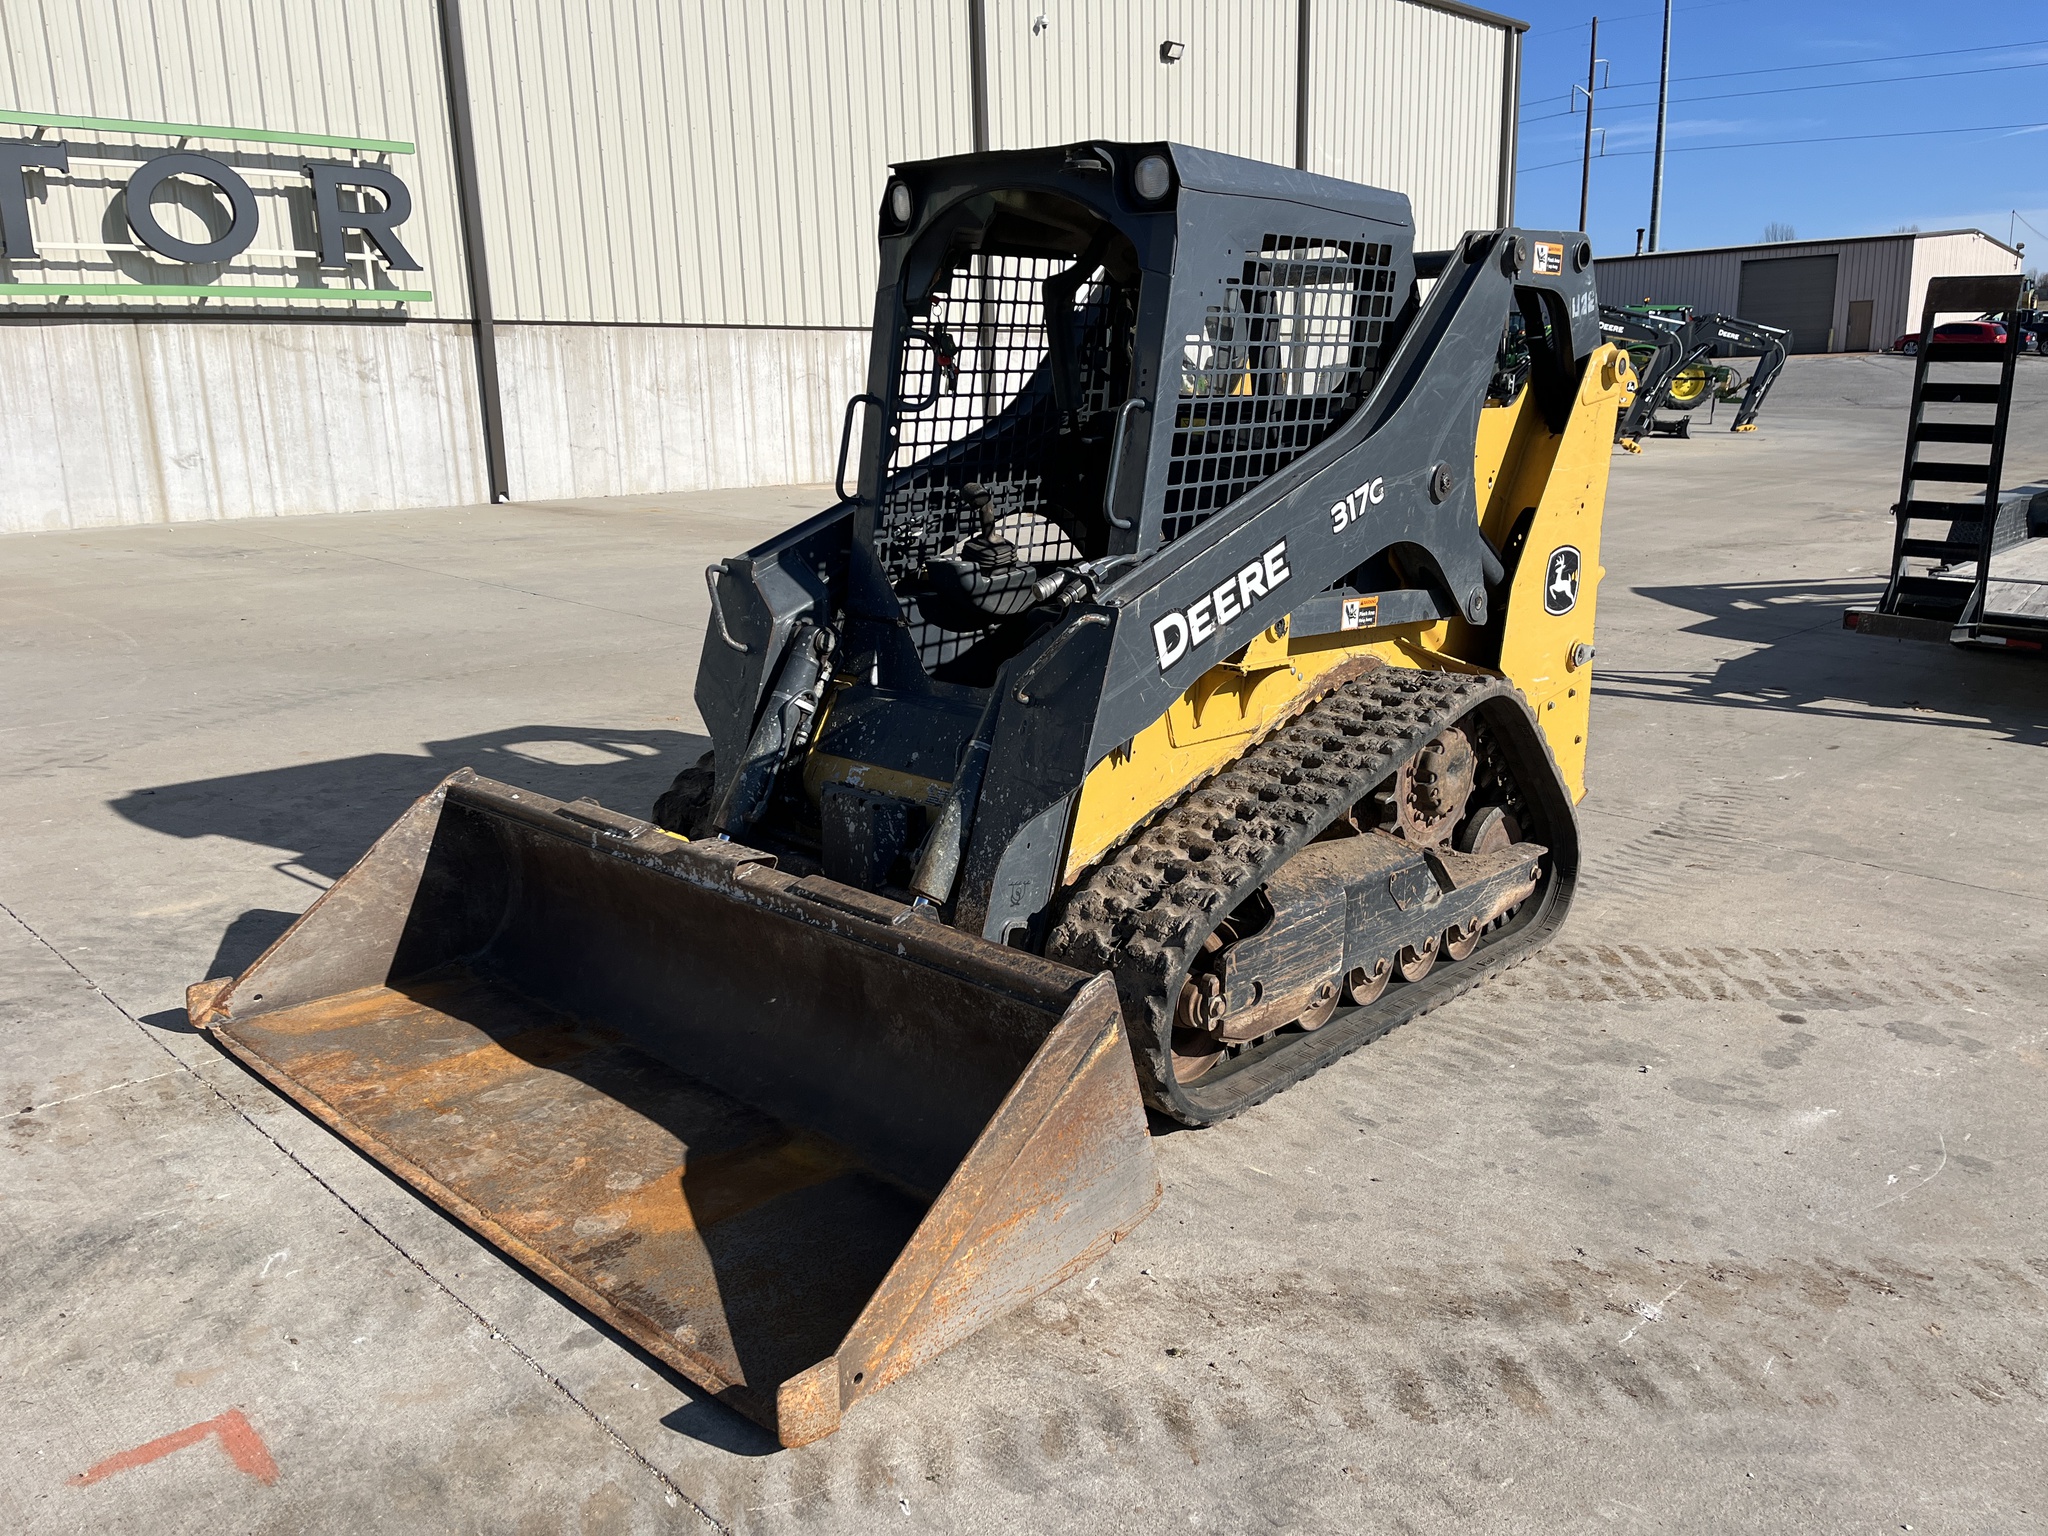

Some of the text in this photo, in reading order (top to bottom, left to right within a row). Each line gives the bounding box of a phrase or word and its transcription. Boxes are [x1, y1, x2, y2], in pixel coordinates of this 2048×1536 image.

[1599, 321, 1625, 334] DEERE
[1717, 329, 1740, 341] DEERE
[1330, 476, 1385, 534] 317G
[1153, 540, 1290, 670] DEERE
